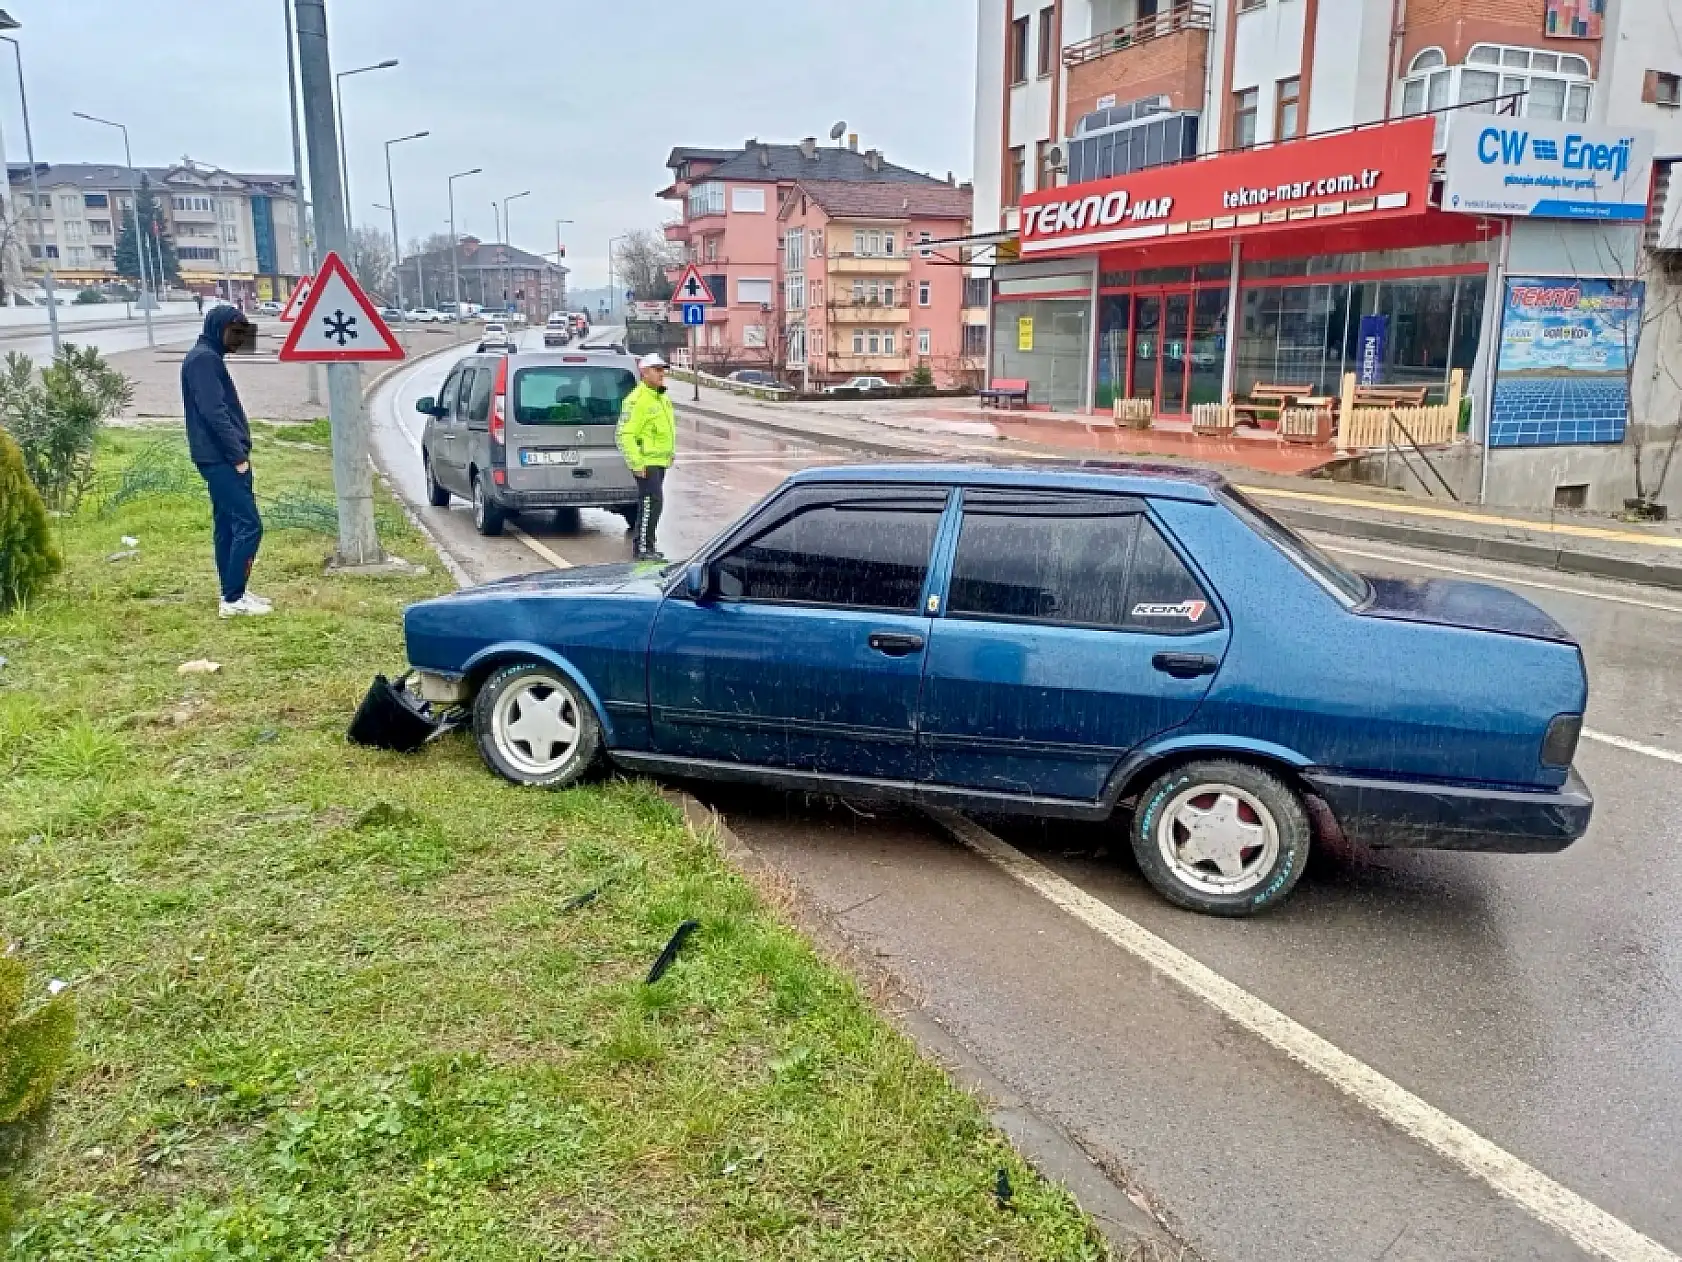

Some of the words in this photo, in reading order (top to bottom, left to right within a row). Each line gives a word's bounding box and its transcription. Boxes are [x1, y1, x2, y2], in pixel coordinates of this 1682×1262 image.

[1478, 126, 1529, 166] CW
[1562, 133, 1631, 182] Enerji
[1223, 168, 1380, 209] tekno-mar.com.tr
[1511, 286, 1580, 309] TEKNO
